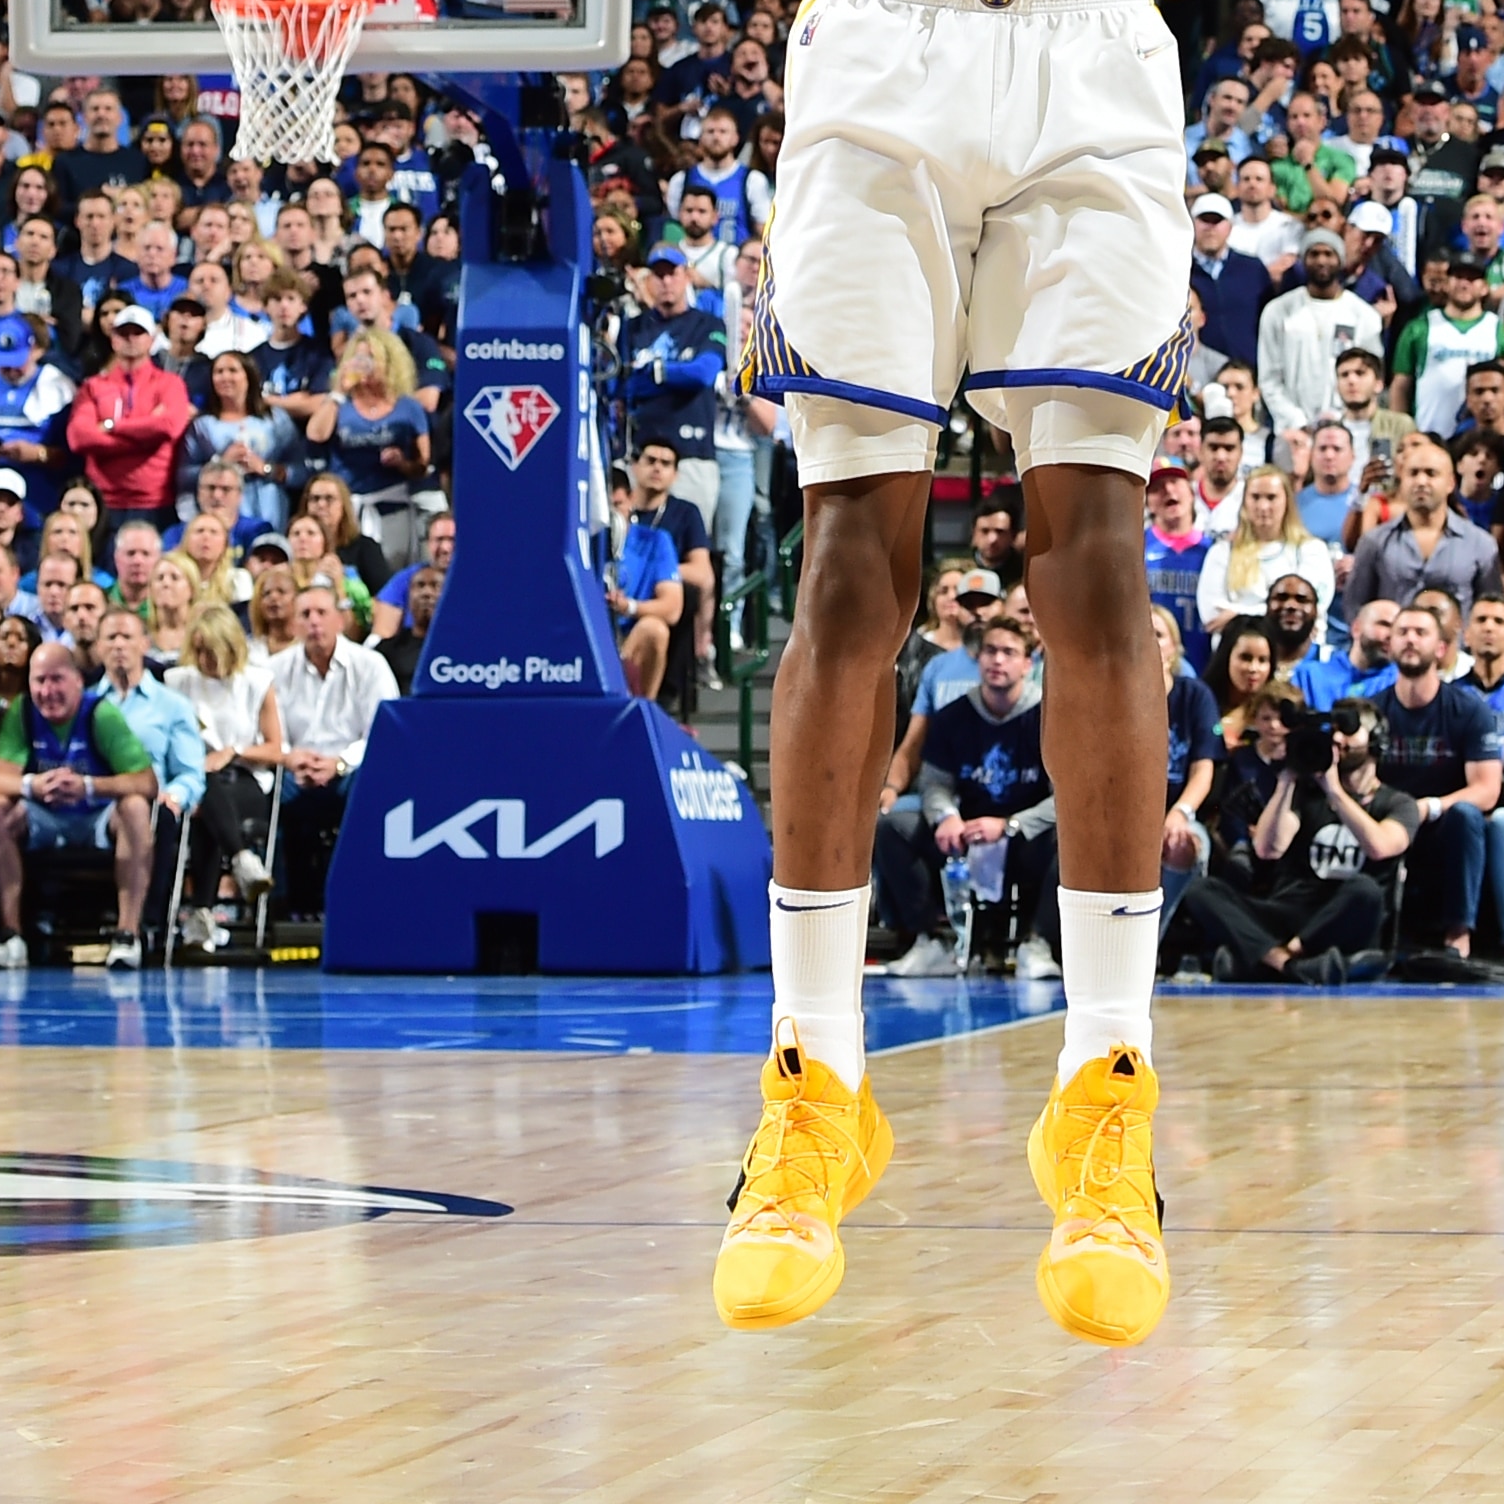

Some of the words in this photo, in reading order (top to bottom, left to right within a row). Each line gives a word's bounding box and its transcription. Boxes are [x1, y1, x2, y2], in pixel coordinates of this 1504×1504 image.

[464, 337, 565, 361] coinbase
[429, 656, 521, 690] Google
[525, 656, 583, 683] Pixel
